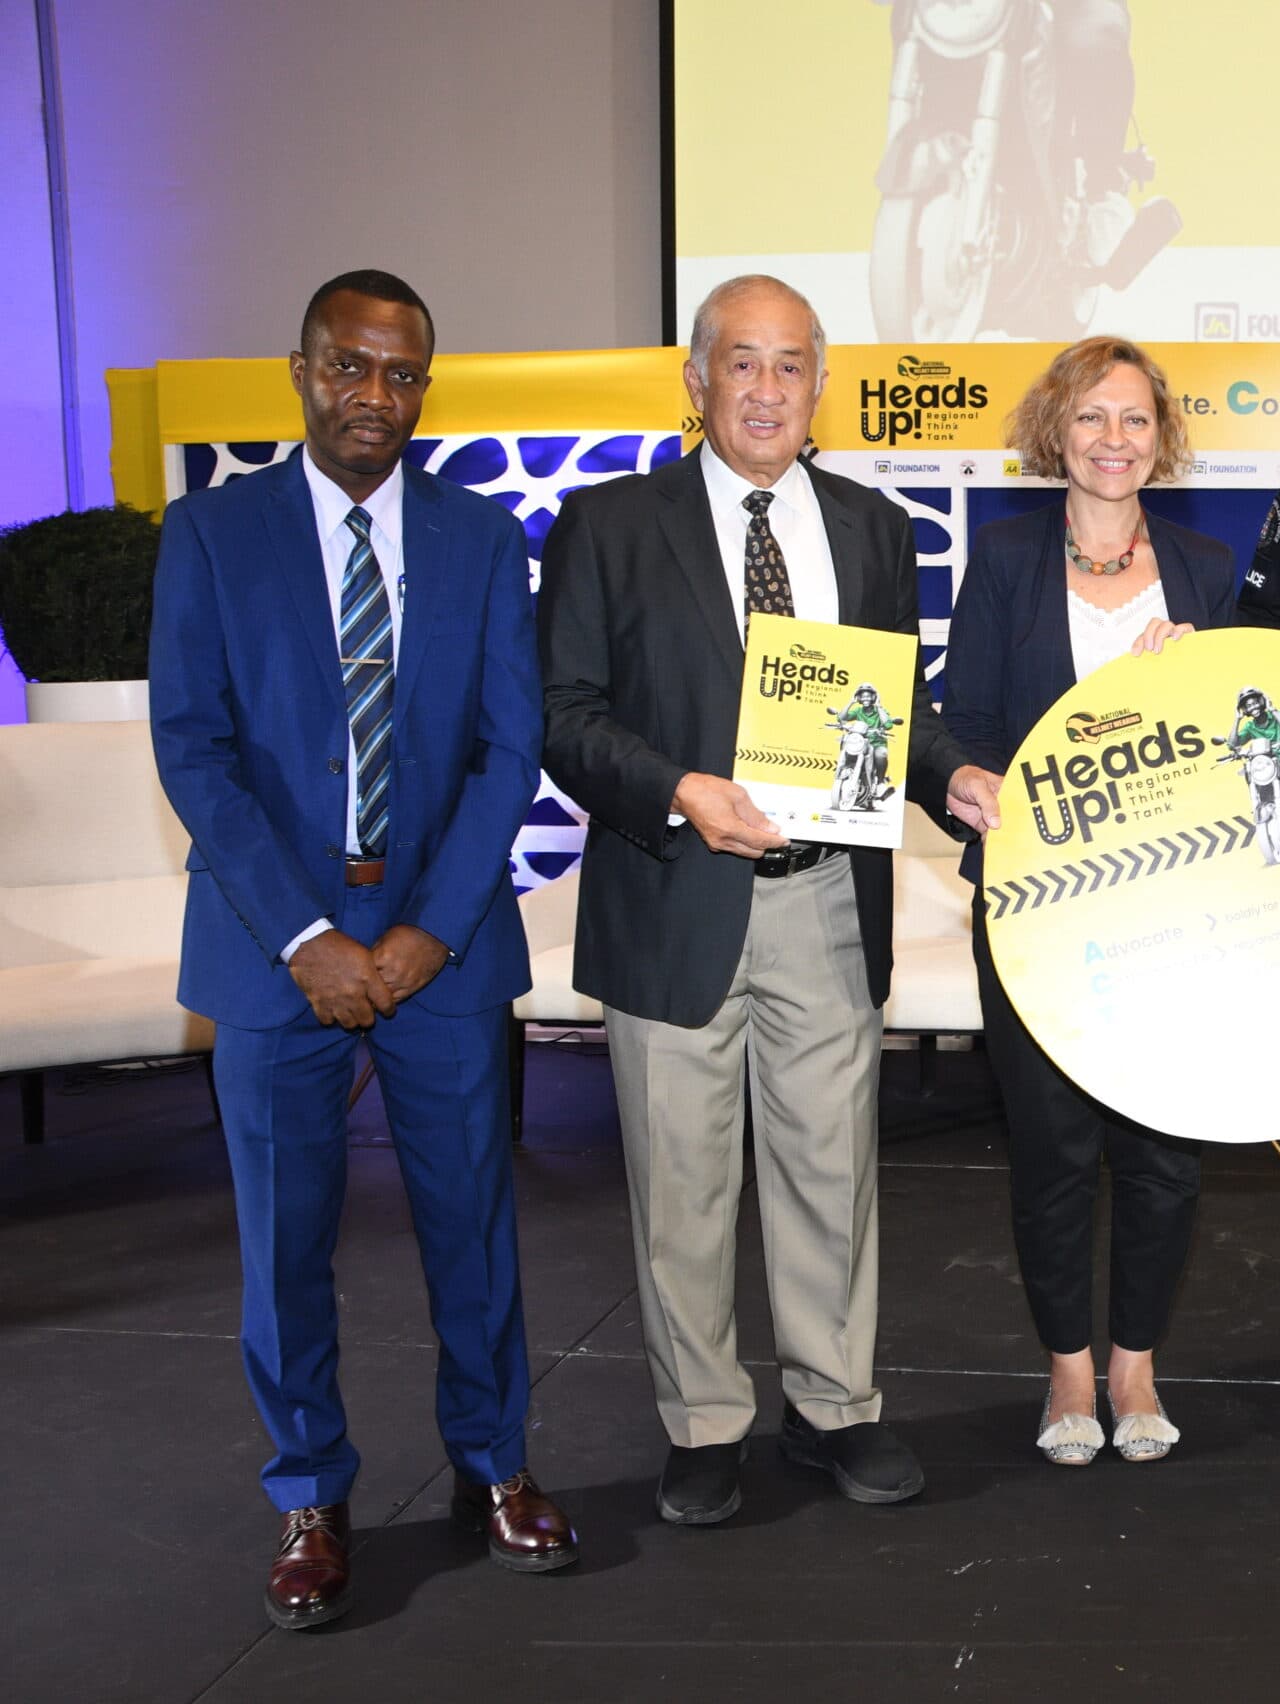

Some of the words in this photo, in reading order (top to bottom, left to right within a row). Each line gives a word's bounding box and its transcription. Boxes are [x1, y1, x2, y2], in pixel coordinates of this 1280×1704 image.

[861, 376, 989, 409] Heads
[861, 408, 923, 446] Up!
[926, 411, 979, 422] Regional
[926, 433, 955, 441] Tank
[893, 464, 941, 473] FOUNDATION
[1209, 464, 1258, 474] FOUNDATION
[1245, 568, 1266, 589] LICE
[761, 654, 850, 686] Heads
[759, 675, 803, 703] Up!
[1020, 720, 1206, 803] Heads
[1125, 763, 1199, 792] Regional
[1129, 786, 1175, 807] Think
[1031, 780, 1127, 846] Up!
[1133, 803, 1173, 821] Tank
[1084, 926, 1184, 966] Advocate
